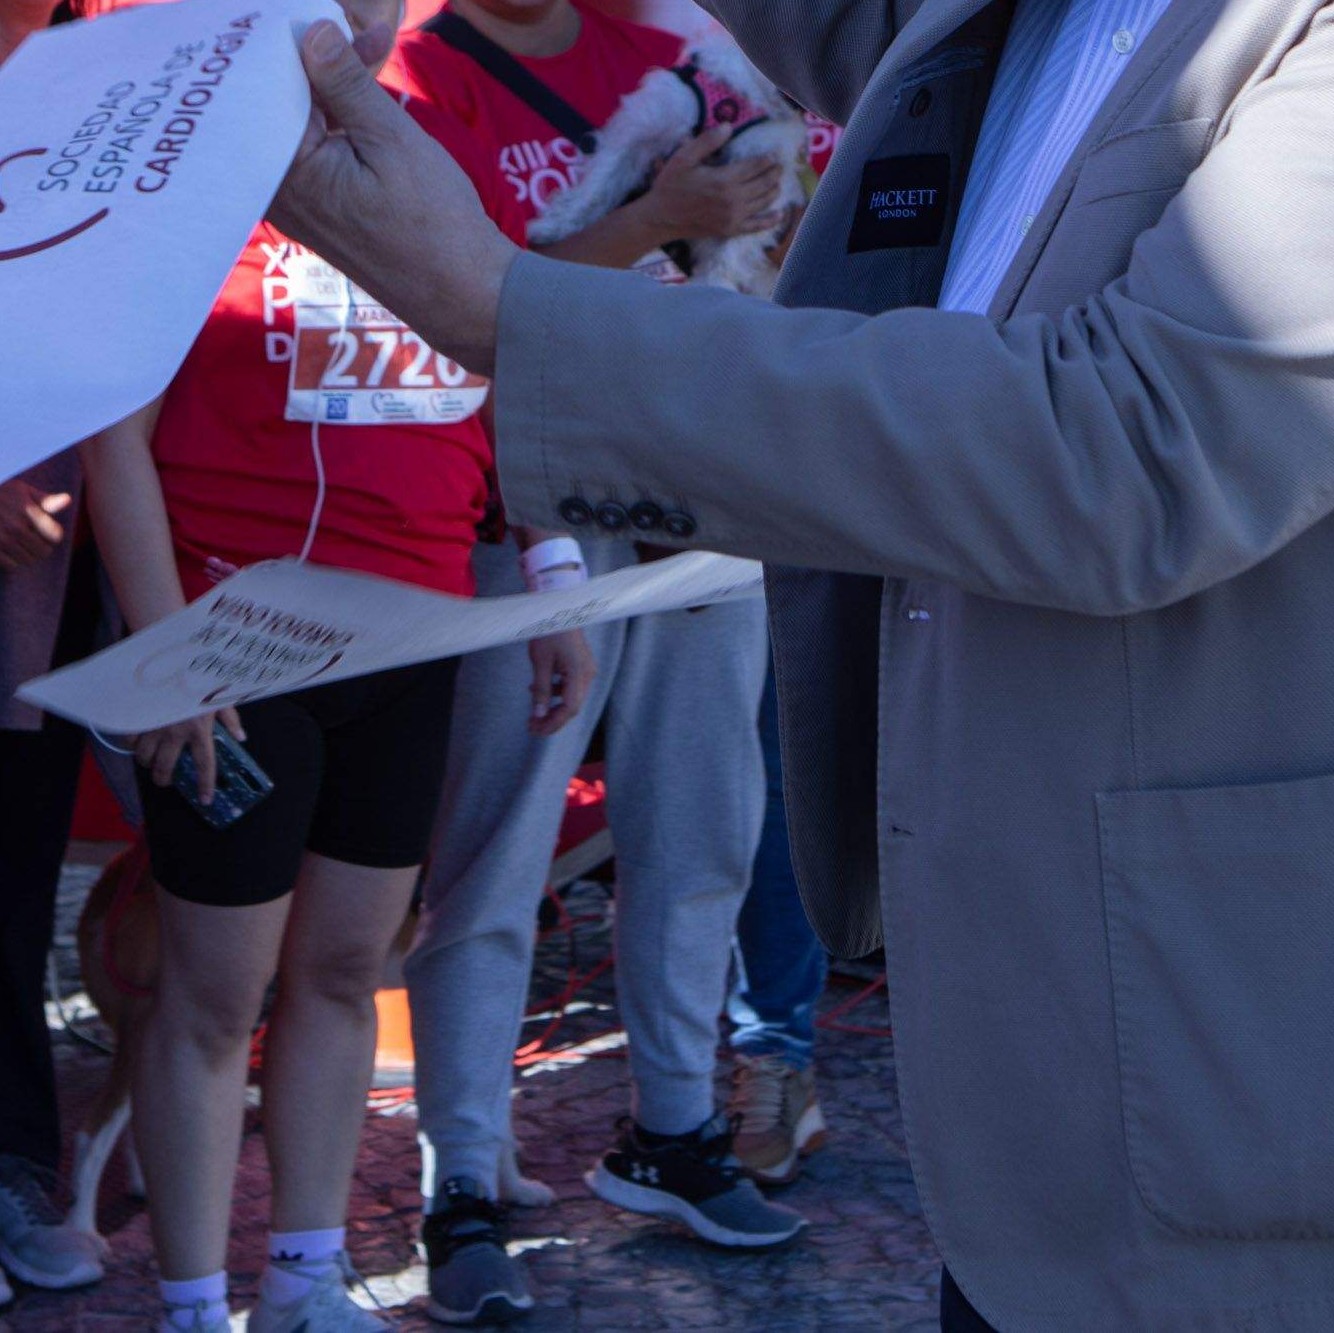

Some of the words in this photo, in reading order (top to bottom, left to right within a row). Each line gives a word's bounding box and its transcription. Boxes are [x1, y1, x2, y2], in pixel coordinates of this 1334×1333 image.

[38, 80, 137, 192] SOCIEDAD
[83, 71, 183, 194] ESPAÑOLA
[134, 11, 263, 194] CARDIOLOGÍA
[869, 189, 937, 210] HACKETT
[878, 208, 917, 219] LONDON
